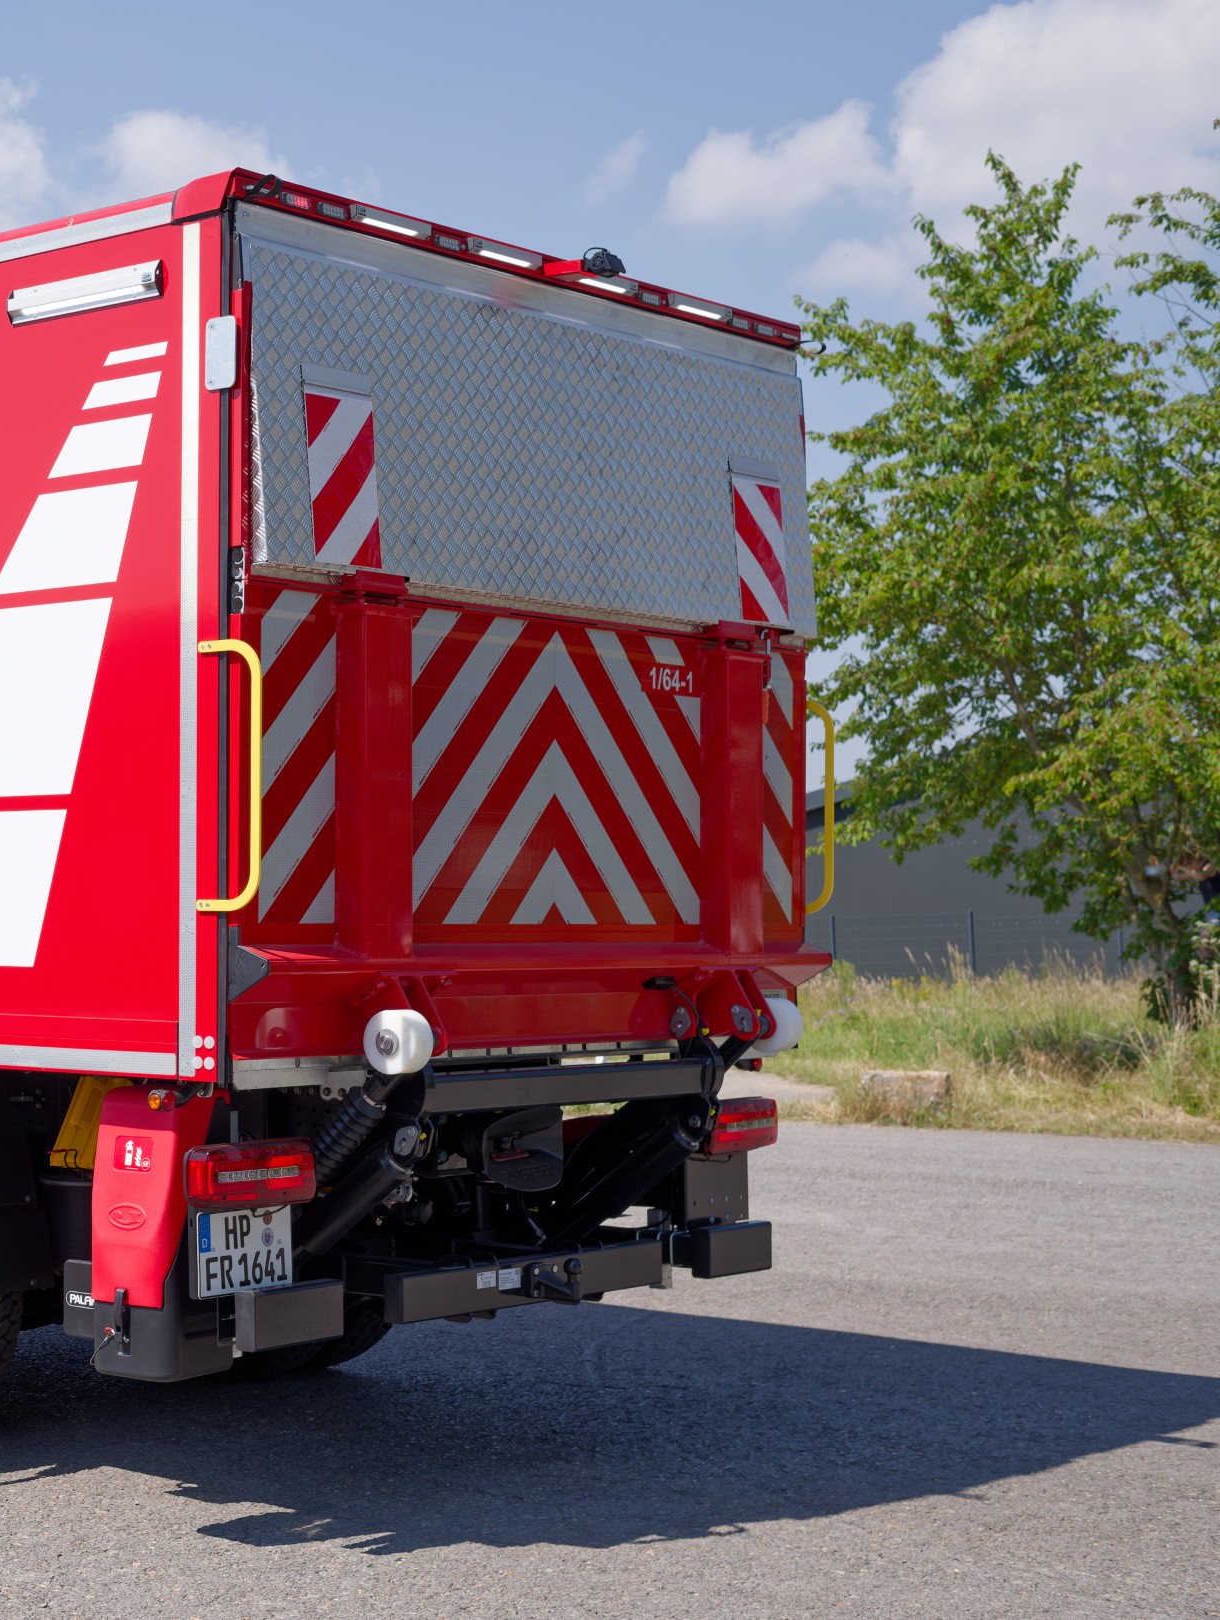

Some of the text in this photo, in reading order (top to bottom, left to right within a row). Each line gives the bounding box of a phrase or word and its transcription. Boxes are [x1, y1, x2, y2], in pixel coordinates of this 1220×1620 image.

[649, 667, 693, 693] 1/64-1
[202, 1238, 208, 1248] D
[224, 1214, 251, 1250] HP
[205, 1247, 287, 1291] FR 1641
